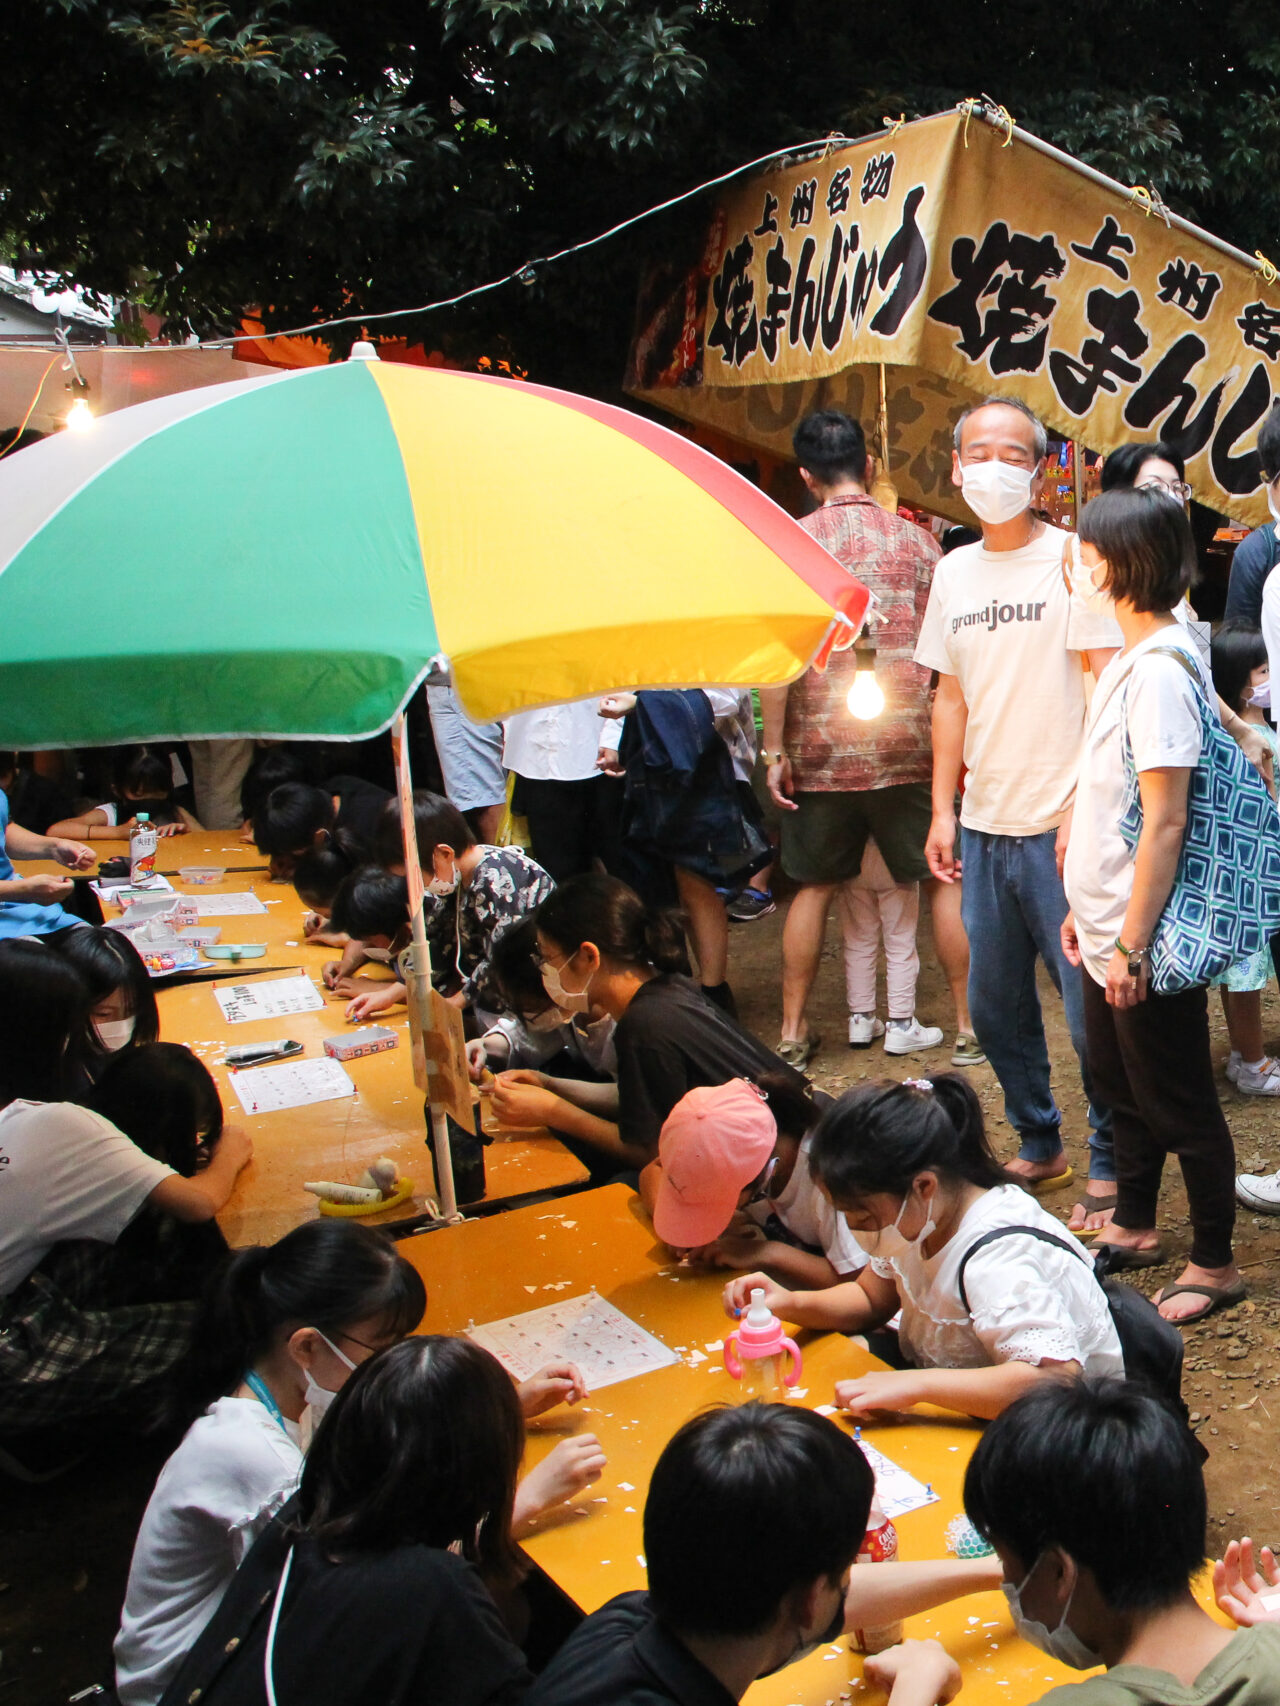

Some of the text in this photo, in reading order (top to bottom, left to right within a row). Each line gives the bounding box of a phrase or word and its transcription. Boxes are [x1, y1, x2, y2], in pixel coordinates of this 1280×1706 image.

[753, 152, 896, 236] 上州名物
[706, 184, 928, 370] 焼まんじゅう
